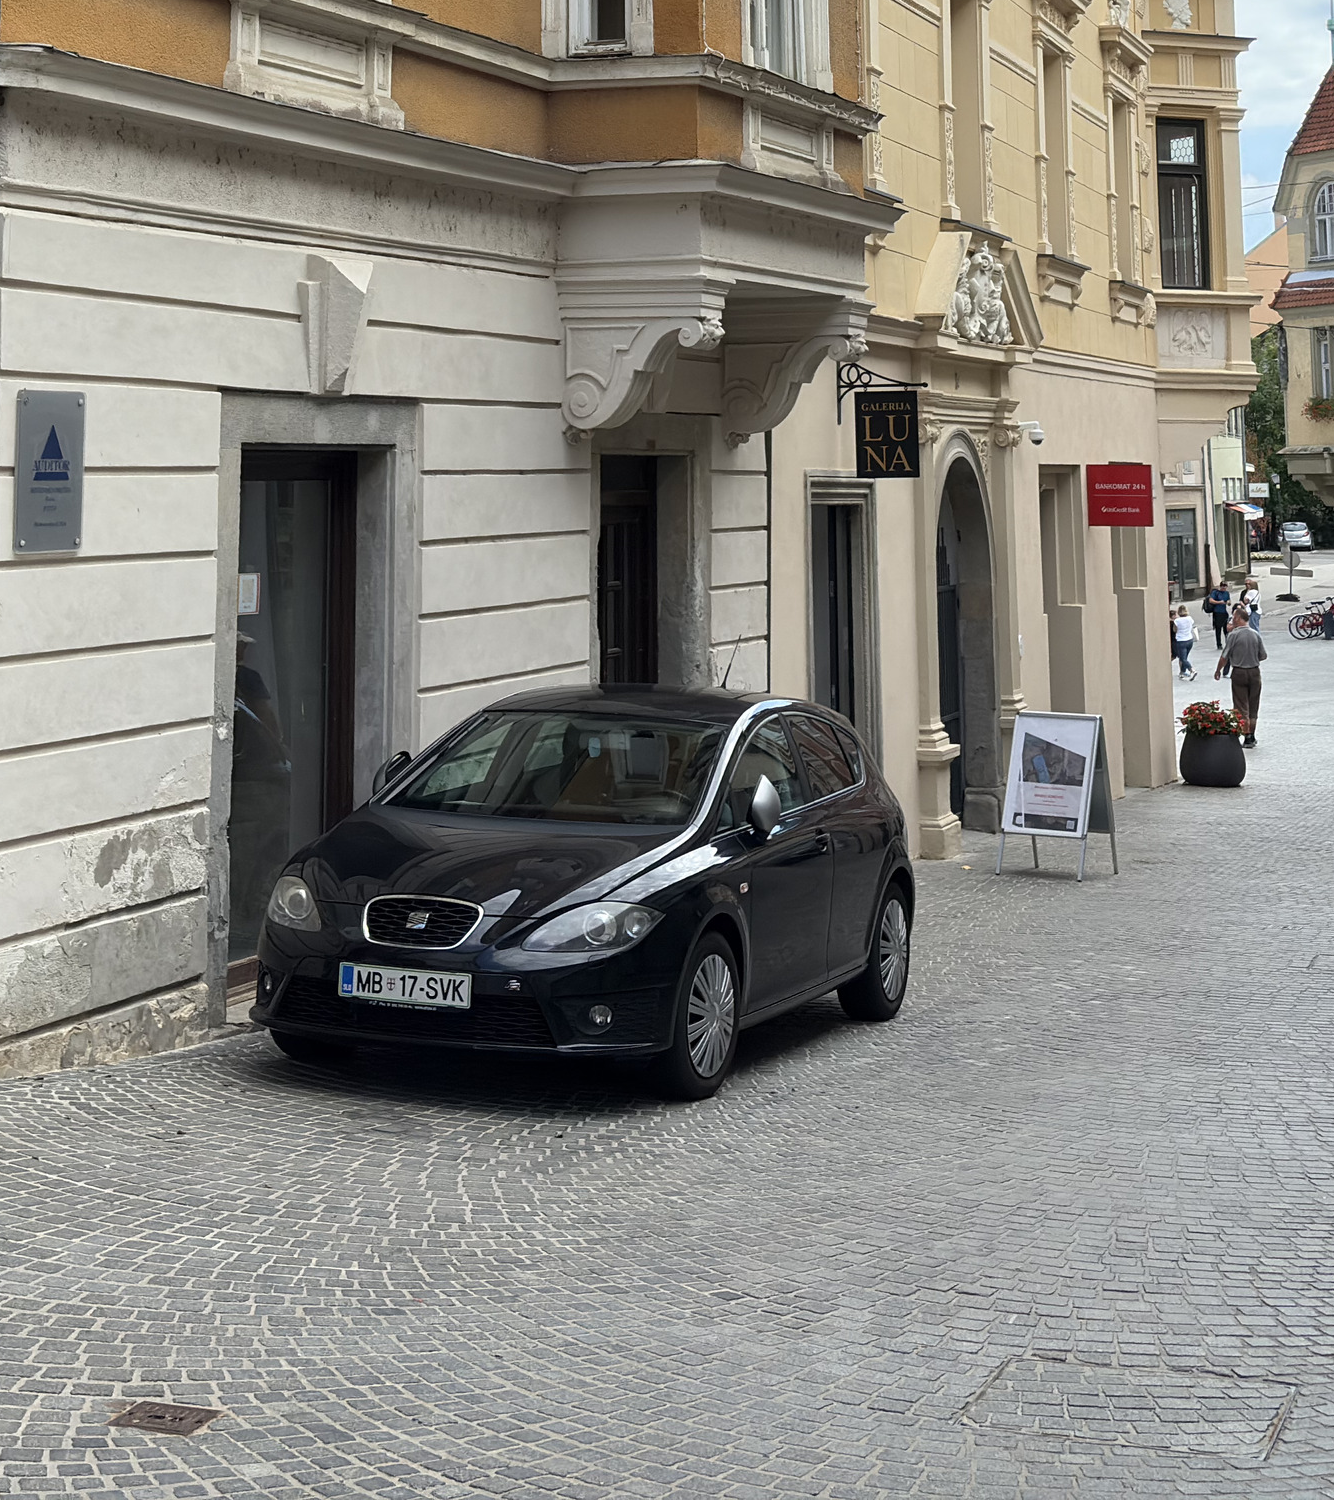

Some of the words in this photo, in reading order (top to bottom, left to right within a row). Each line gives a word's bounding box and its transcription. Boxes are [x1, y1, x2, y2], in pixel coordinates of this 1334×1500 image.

[861, 403, 911, 412] GALERIJA
[862, 415, 911, 441] LU
[32, 459, 70, 471] AUDITOR
[863, 445, 913, 472] NA
[357, 970, 383, 993] MB
[399, 974, 466, 1002] 17-SVK
